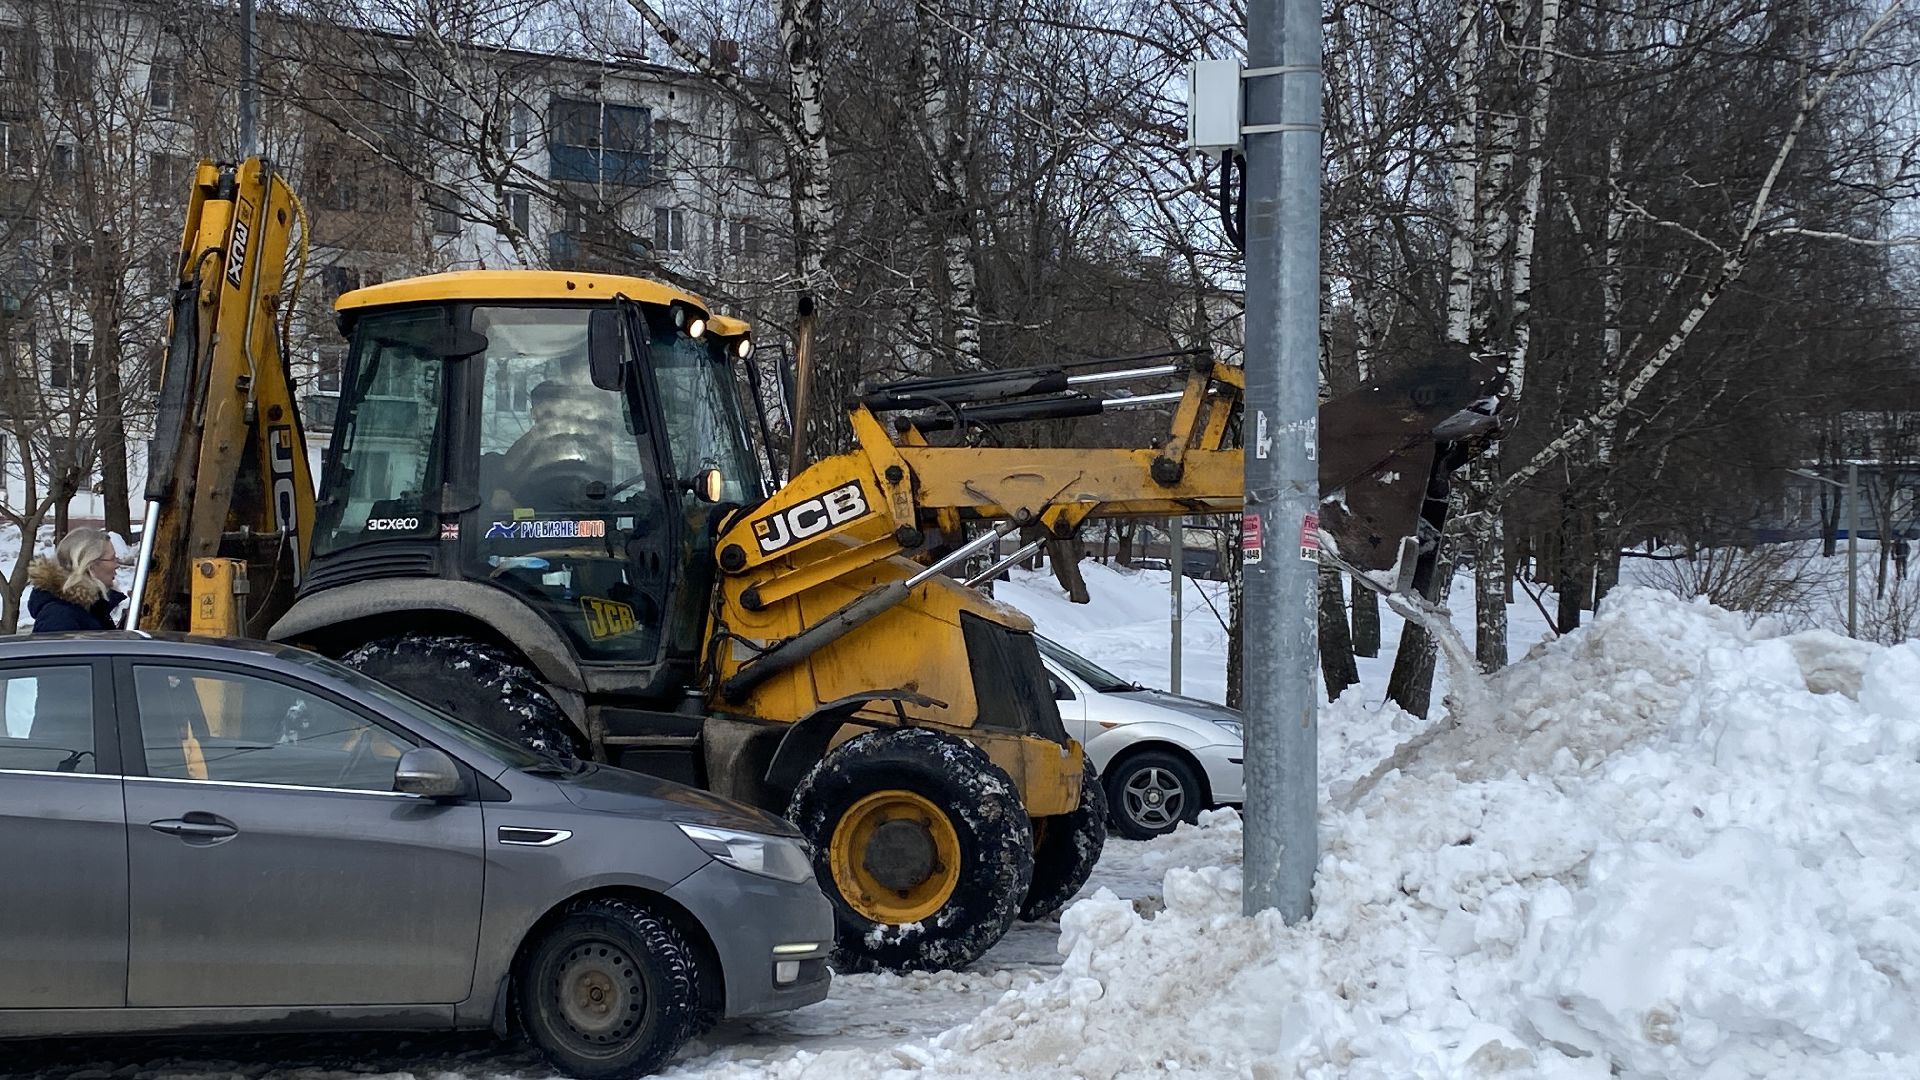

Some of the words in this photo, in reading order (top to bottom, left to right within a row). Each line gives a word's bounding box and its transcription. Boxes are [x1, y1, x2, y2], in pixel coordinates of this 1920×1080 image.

[227, 221, 249, 283] 3CX
[520, 520, 605, 538] РУСБИЗНЕСАВТО
[759, 484, 867, 552] JCB
[590, 600, 635, 637] JCB
